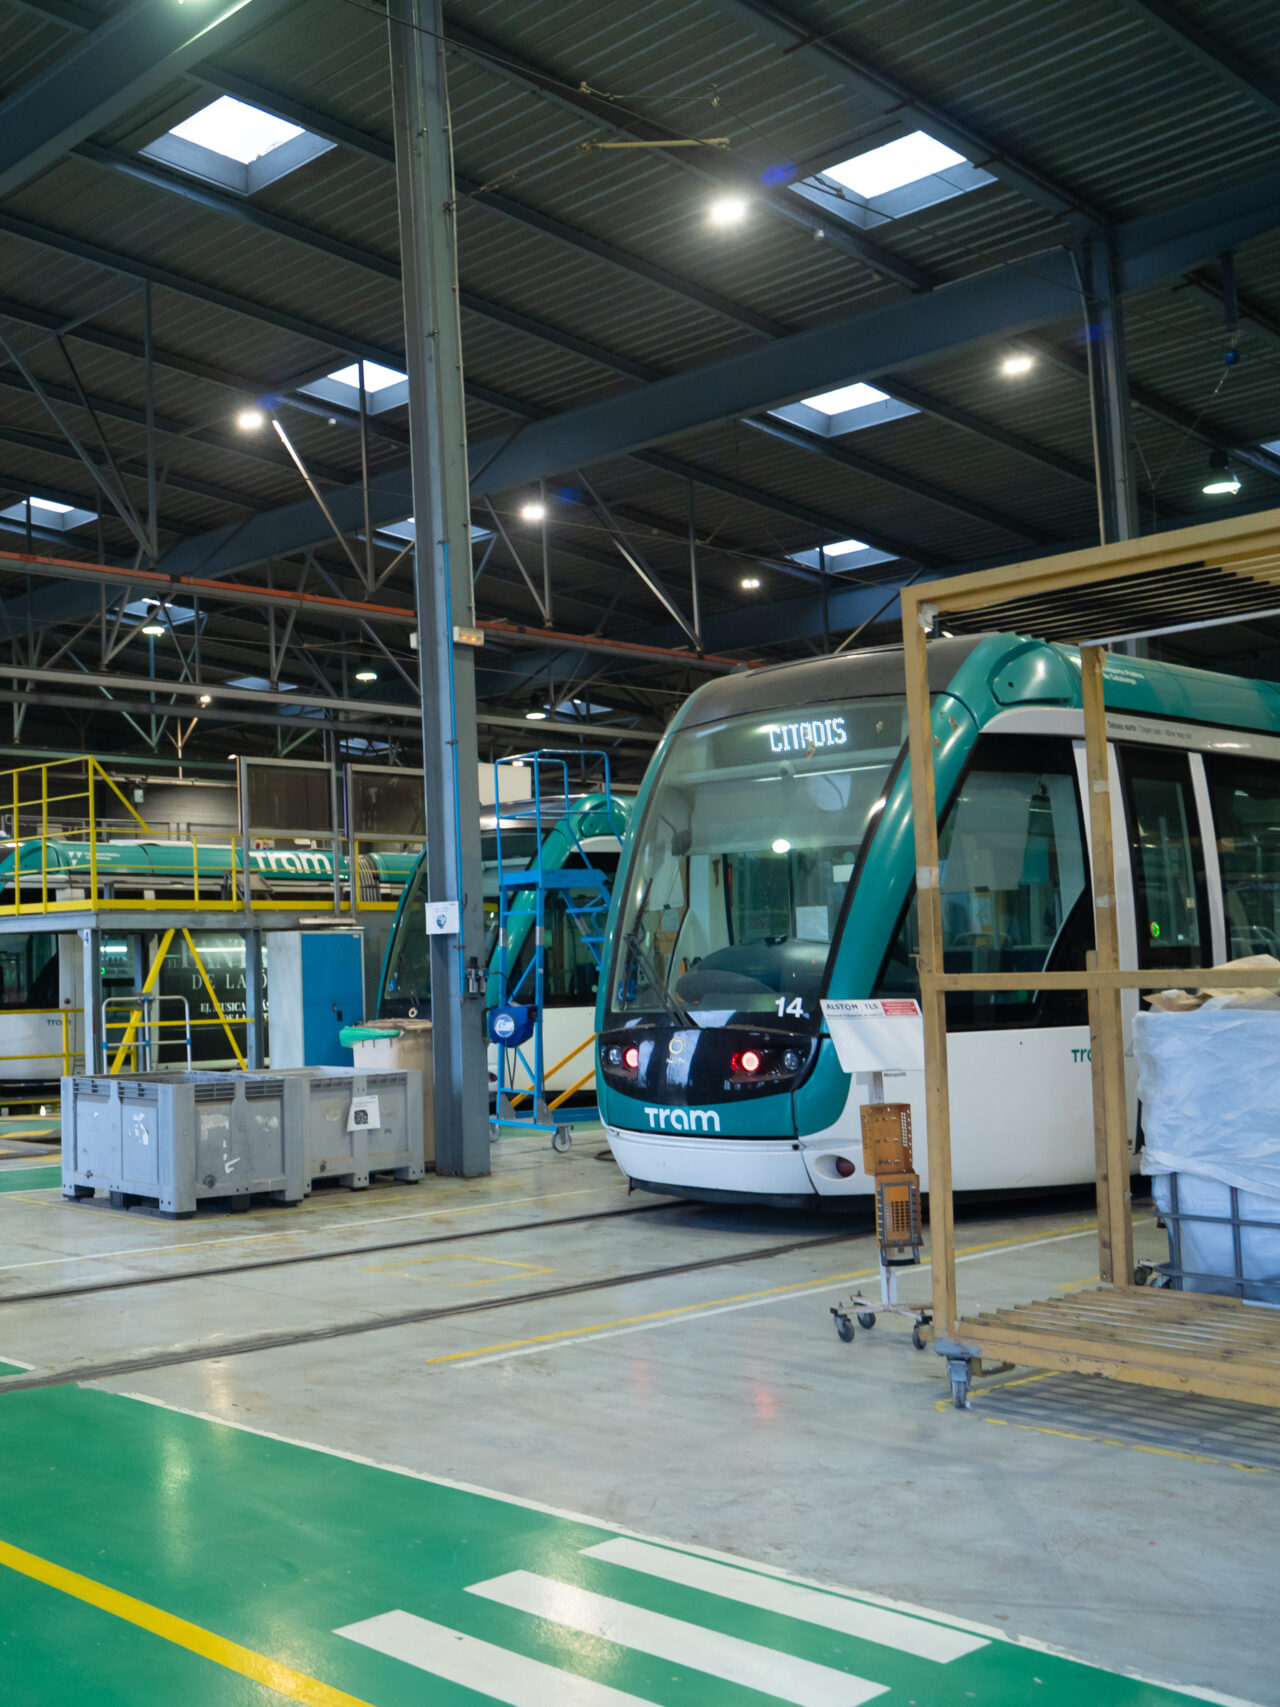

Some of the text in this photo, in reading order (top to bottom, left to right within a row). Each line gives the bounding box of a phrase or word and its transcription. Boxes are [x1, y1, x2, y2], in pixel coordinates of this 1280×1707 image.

[769, 717, 848, 752] CITADIS
[775, 996, 804, 1019] 14
[826, 1003, 859, 1011] ALSTOM
[644, 1106, 721, 1132] Tram
